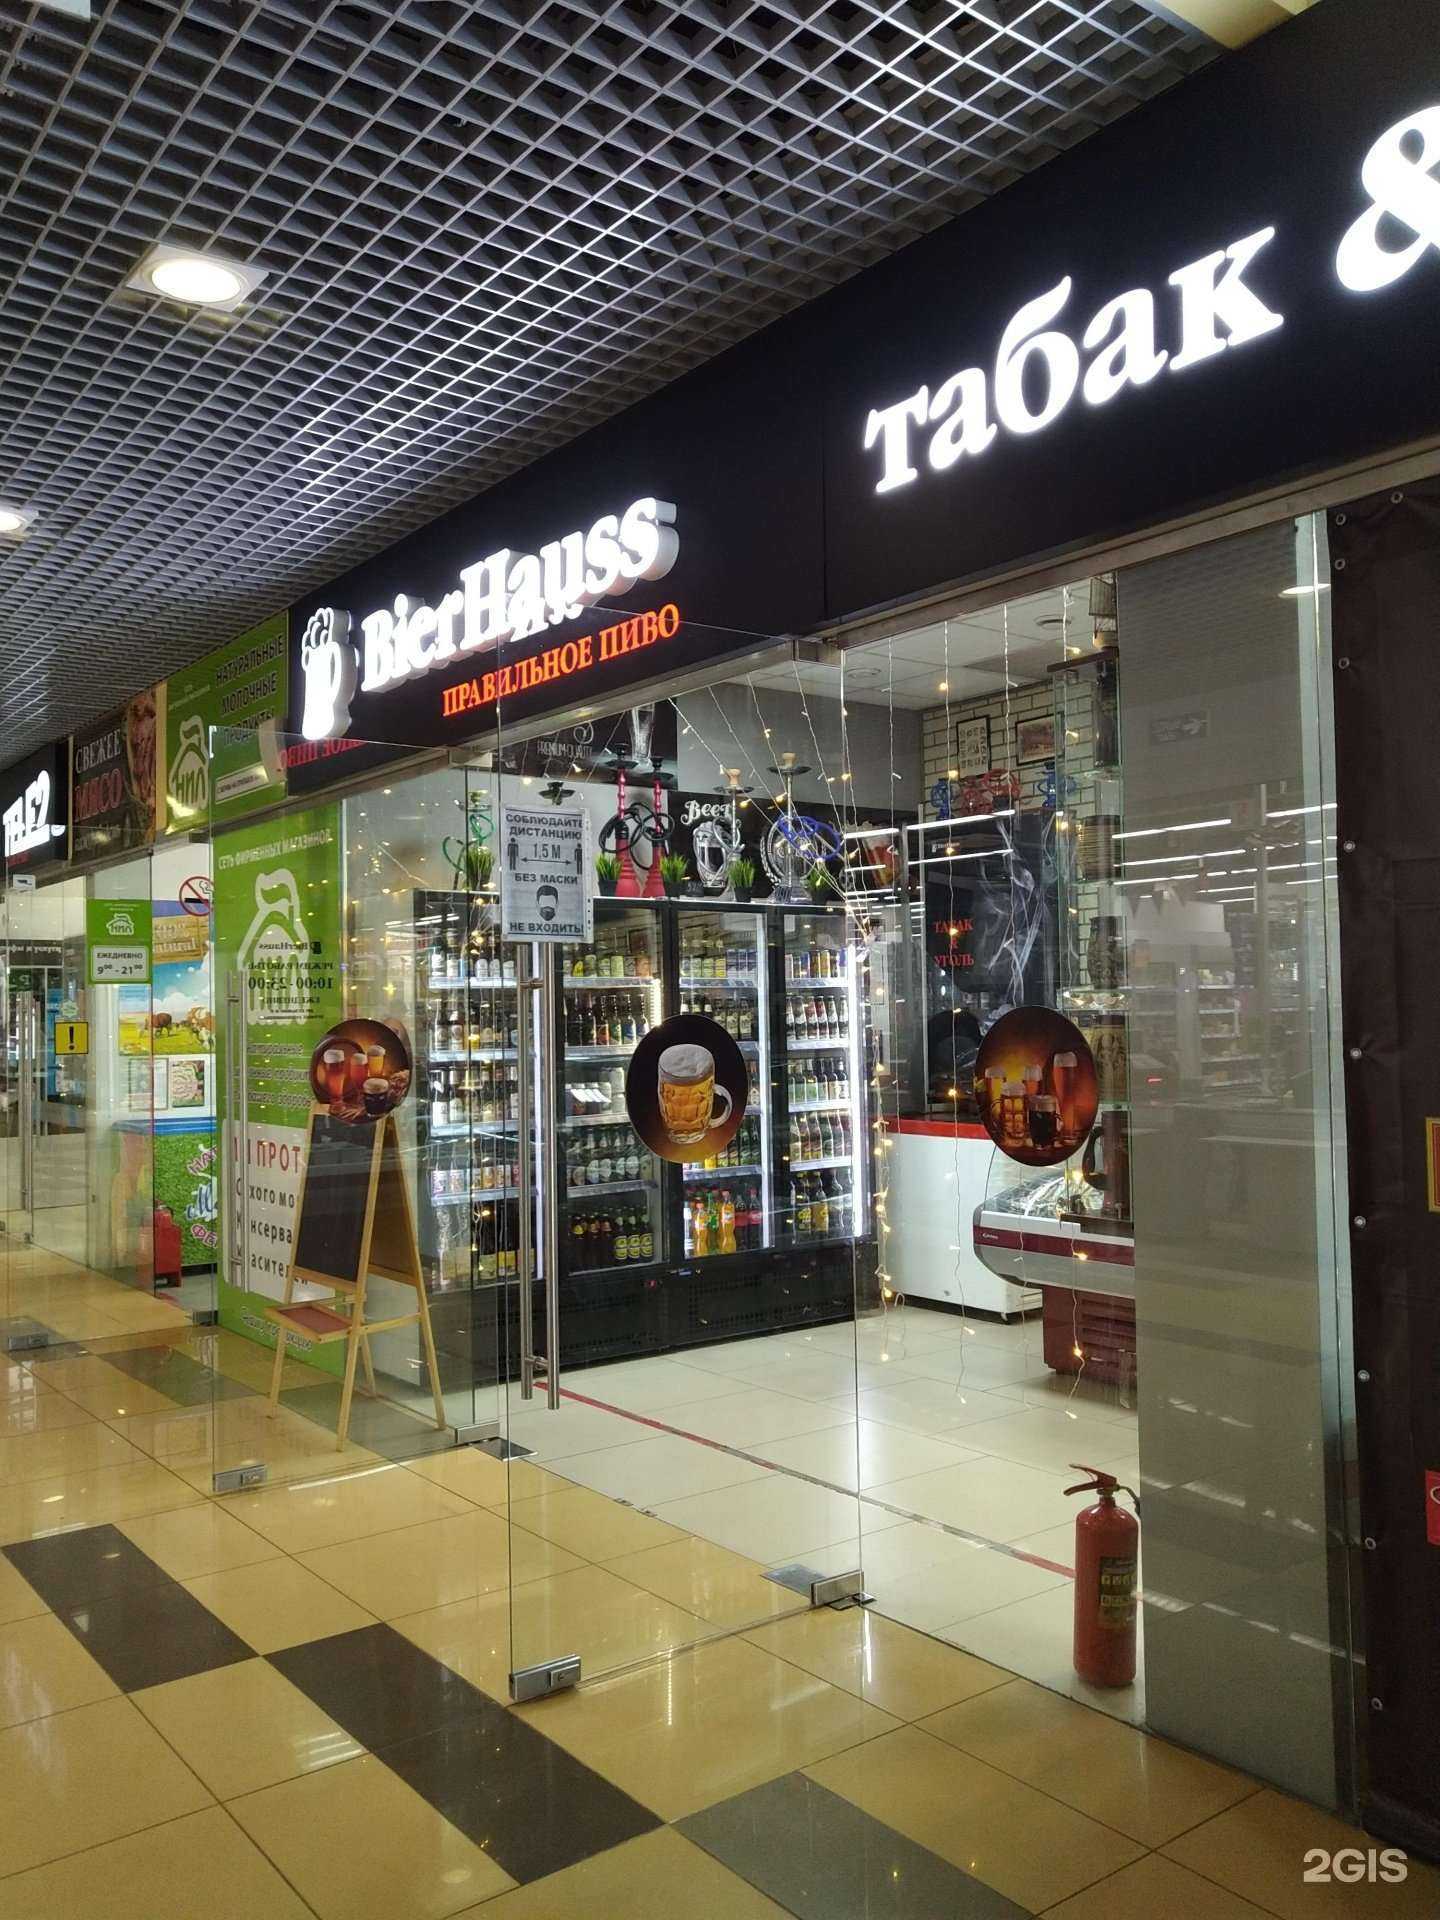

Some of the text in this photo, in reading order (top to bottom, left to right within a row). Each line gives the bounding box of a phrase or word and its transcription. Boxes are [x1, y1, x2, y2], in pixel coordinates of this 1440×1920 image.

[1335, 103, 1440, 292] &
[360, 497, 677, 692] BierHauss
[442, 603, 681, 717] ПРАВИЛЬНОЕ ПИВО
[75, 729, 121, 774] СВЕЖЕЕ
[509, 826, 582, 841] ДИСТАНЦИЮ
[514, 873, 578, 885] БЕЗ МАСКИ
[509, 922, 525, 931] НЕ
